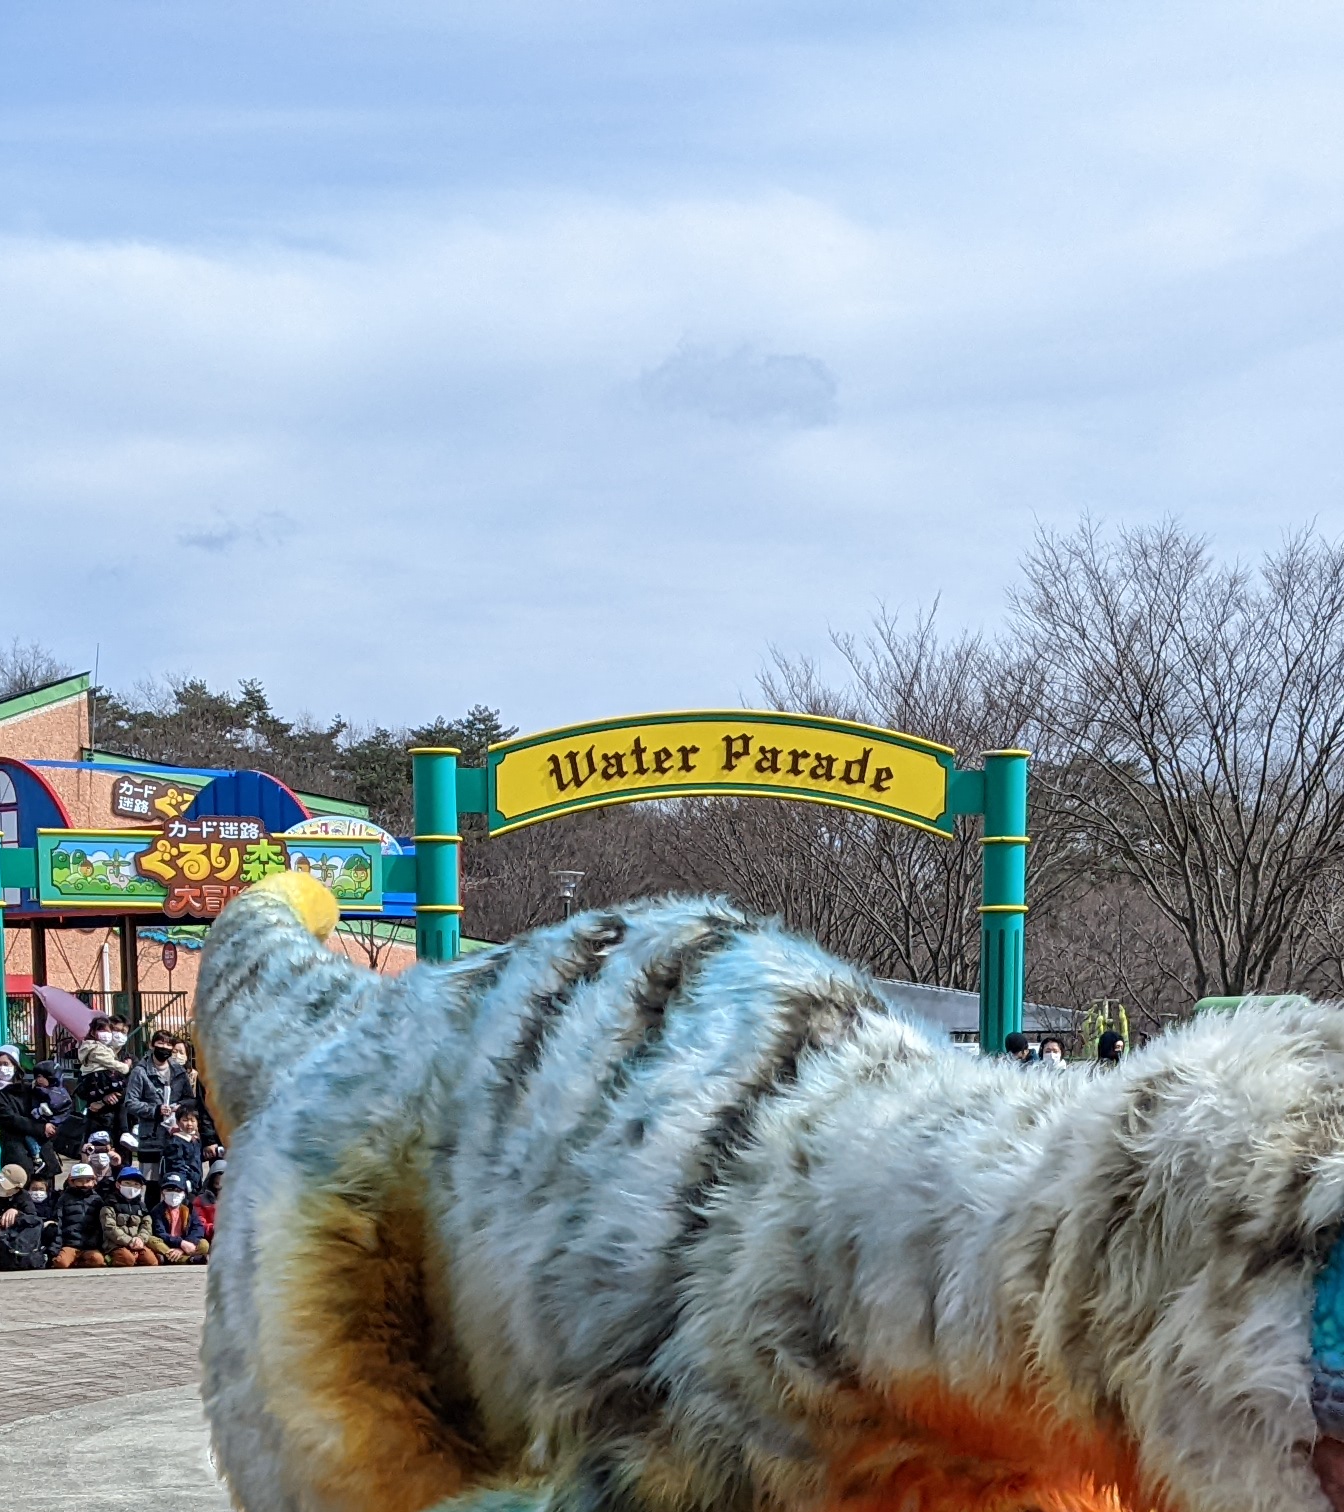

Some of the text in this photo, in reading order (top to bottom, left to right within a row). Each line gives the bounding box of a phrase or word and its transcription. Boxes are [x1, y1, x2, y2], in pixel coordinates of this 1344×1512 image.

[547, 733, 893, 792] Water Parade
[119, 781, 157, 798] カード
[154, 788, 195, 818] ぐ
[118, 796, 149, 814] 迷路
[169, 885, 250, 912] 大冒
